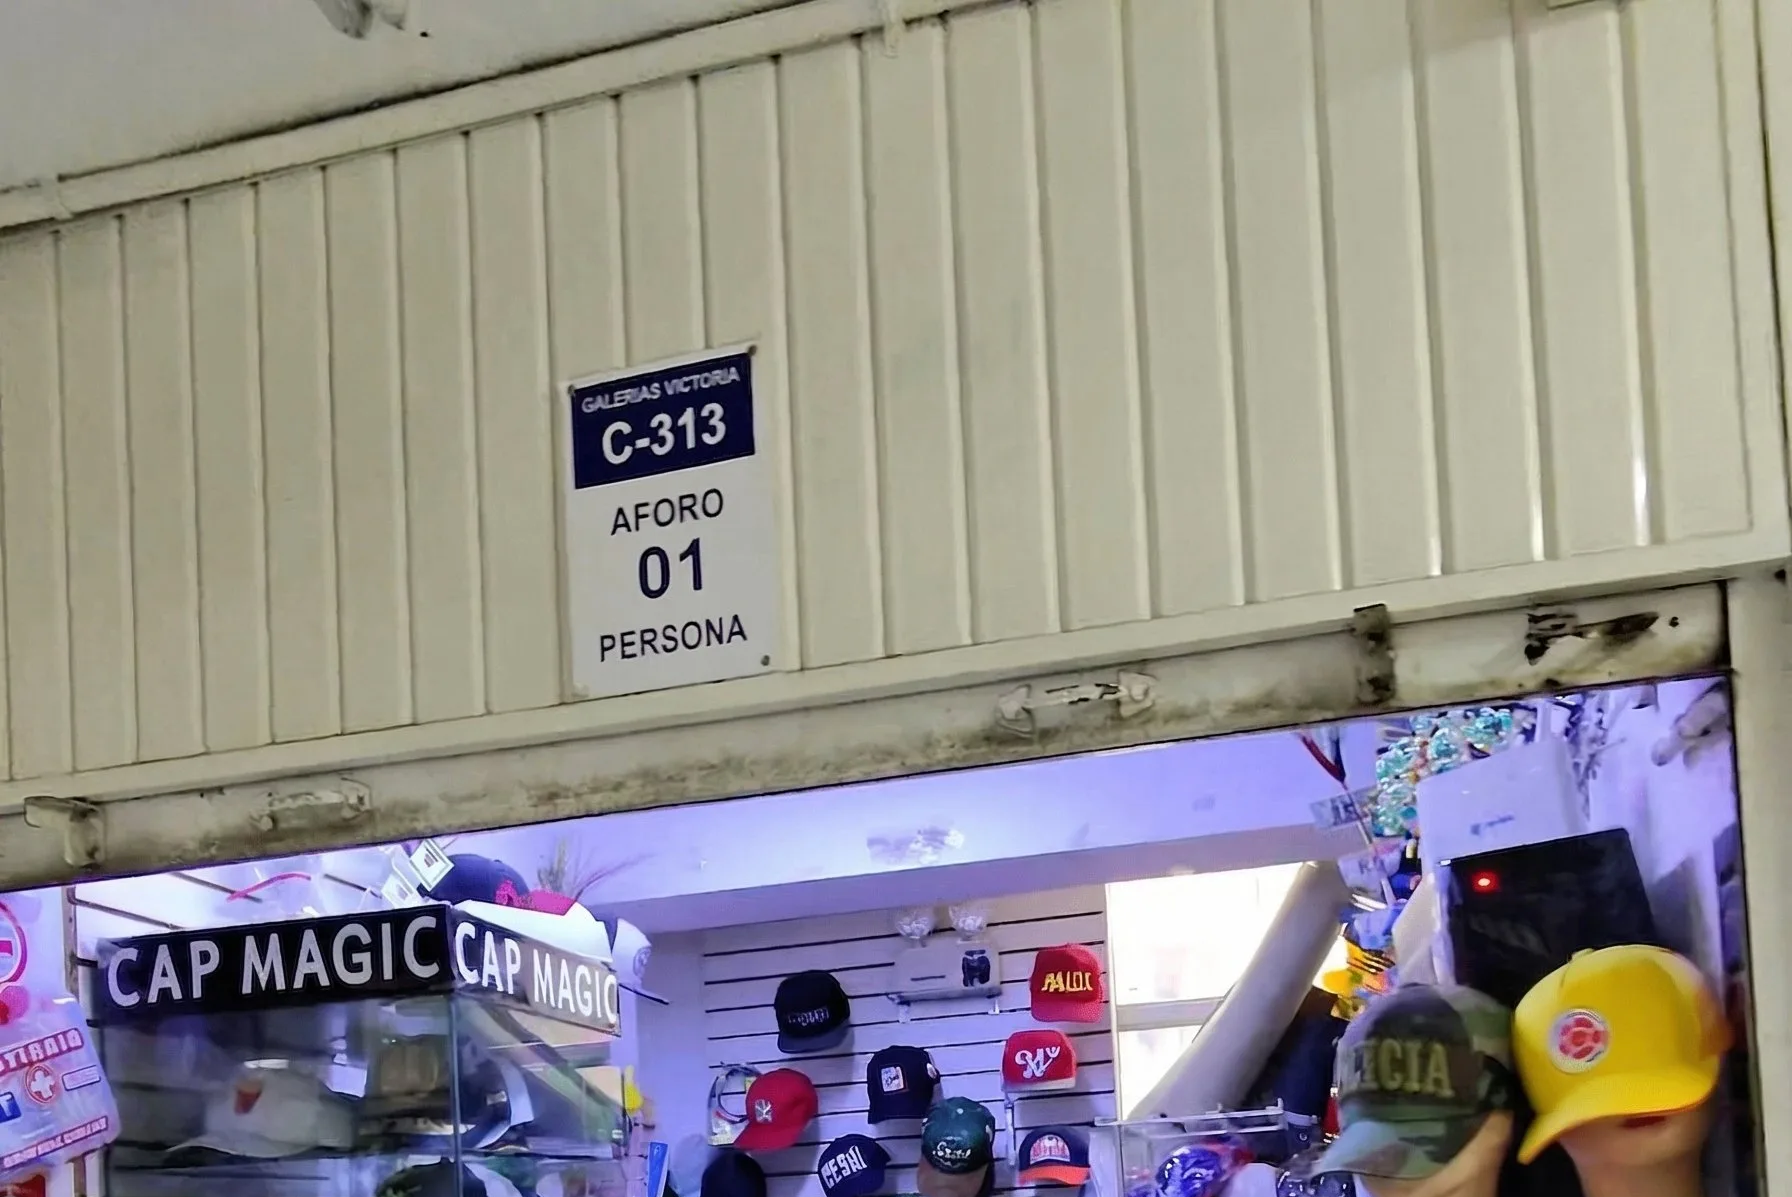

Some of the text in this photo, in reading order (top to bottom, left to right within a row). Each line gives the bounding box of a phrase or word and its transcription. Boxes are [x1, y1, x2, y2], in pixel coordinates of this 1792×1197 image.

[581, 366, 741, 413] GALERIAS VICTORIA
[602, 402, 726, 465] C-313
[611, 488, 724, 535] AFORO
[638, 537, 703, 599] 01
[600, 614, 748, 663] PERSONA
[107, 916, 441, 1007] CAP MAGIC
[454, 921, 618, 1024] CAP MAGIC
